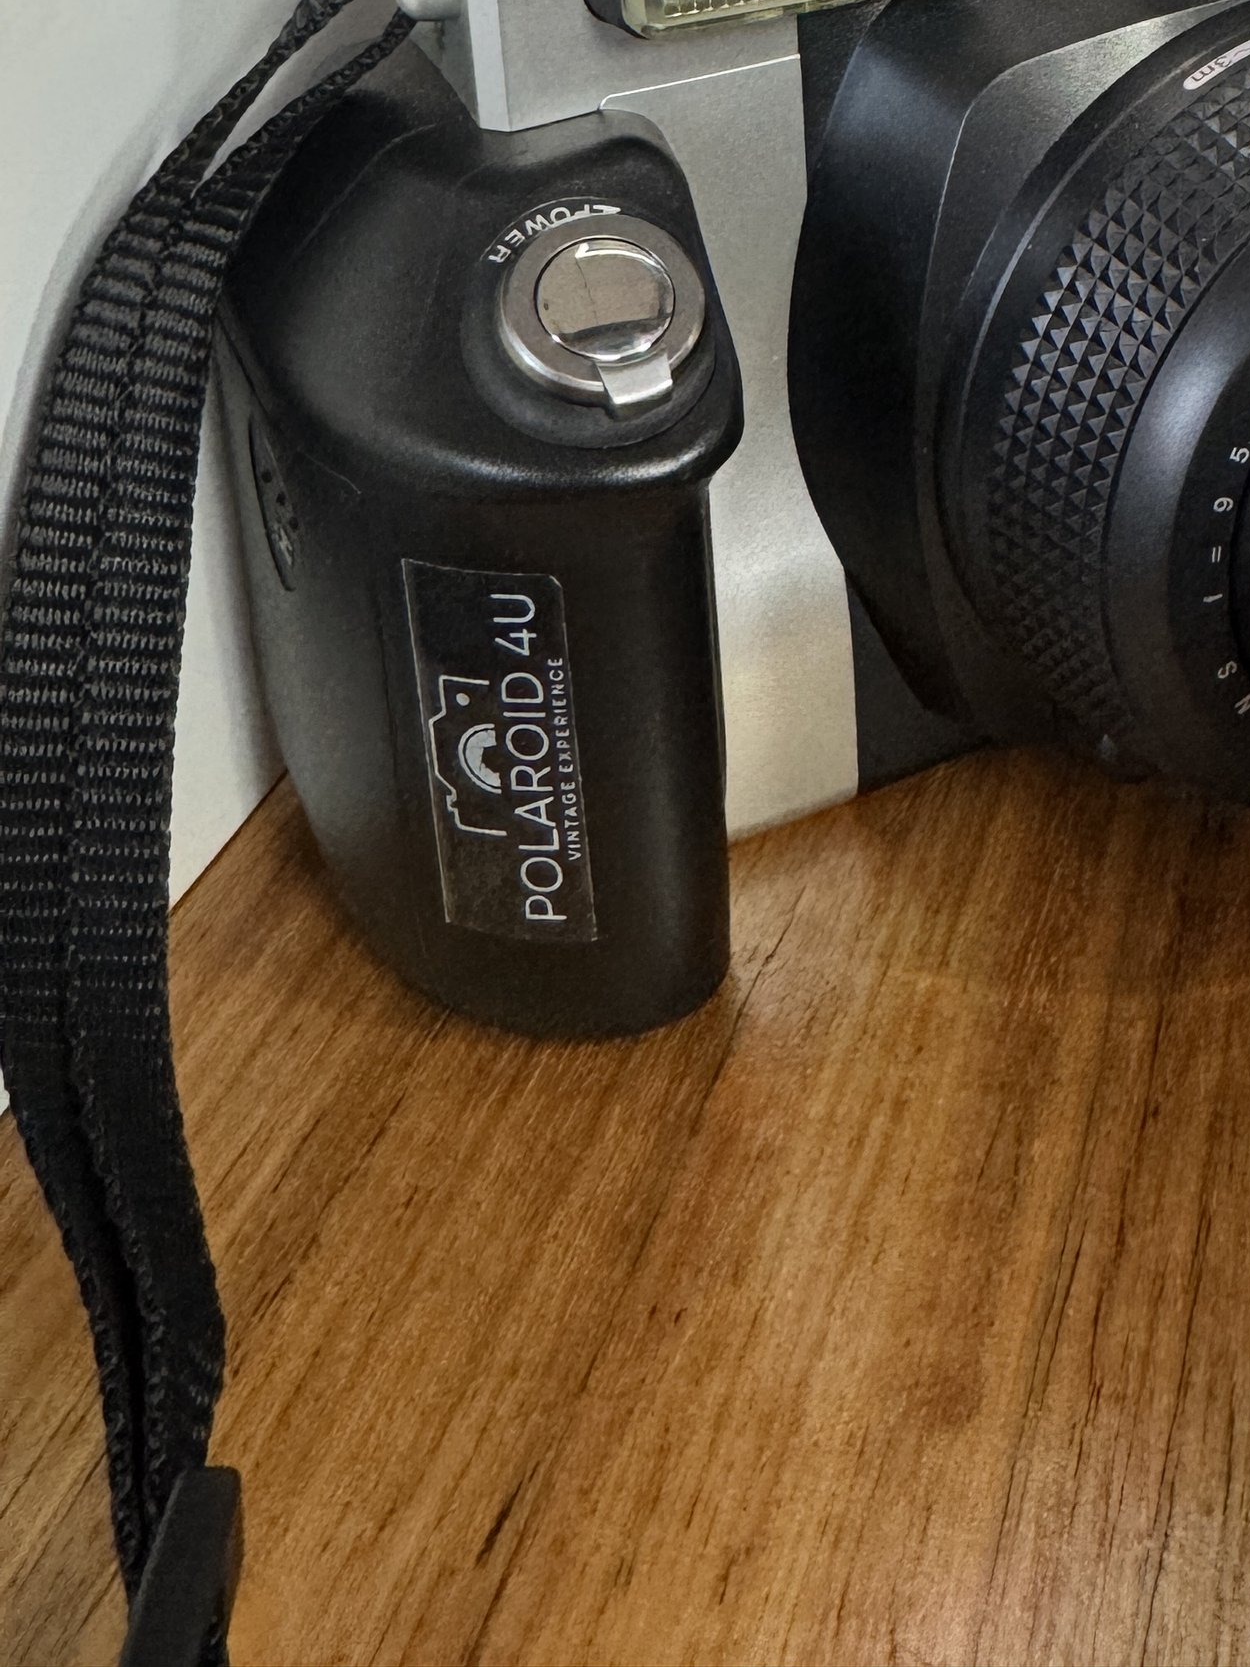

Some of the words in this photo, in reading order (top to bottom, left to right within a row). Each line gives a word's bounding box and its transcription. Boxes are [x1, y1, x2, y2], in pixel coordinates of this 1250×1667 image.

[487, 204, 592, 264] POWER
[489, 593, 538, 656] 4U
[546, 656, 576, 774] EXPERIENCE
[500, 672, 568, 922] POLAROID
[558, 780, 584, 862] VINTAGE
